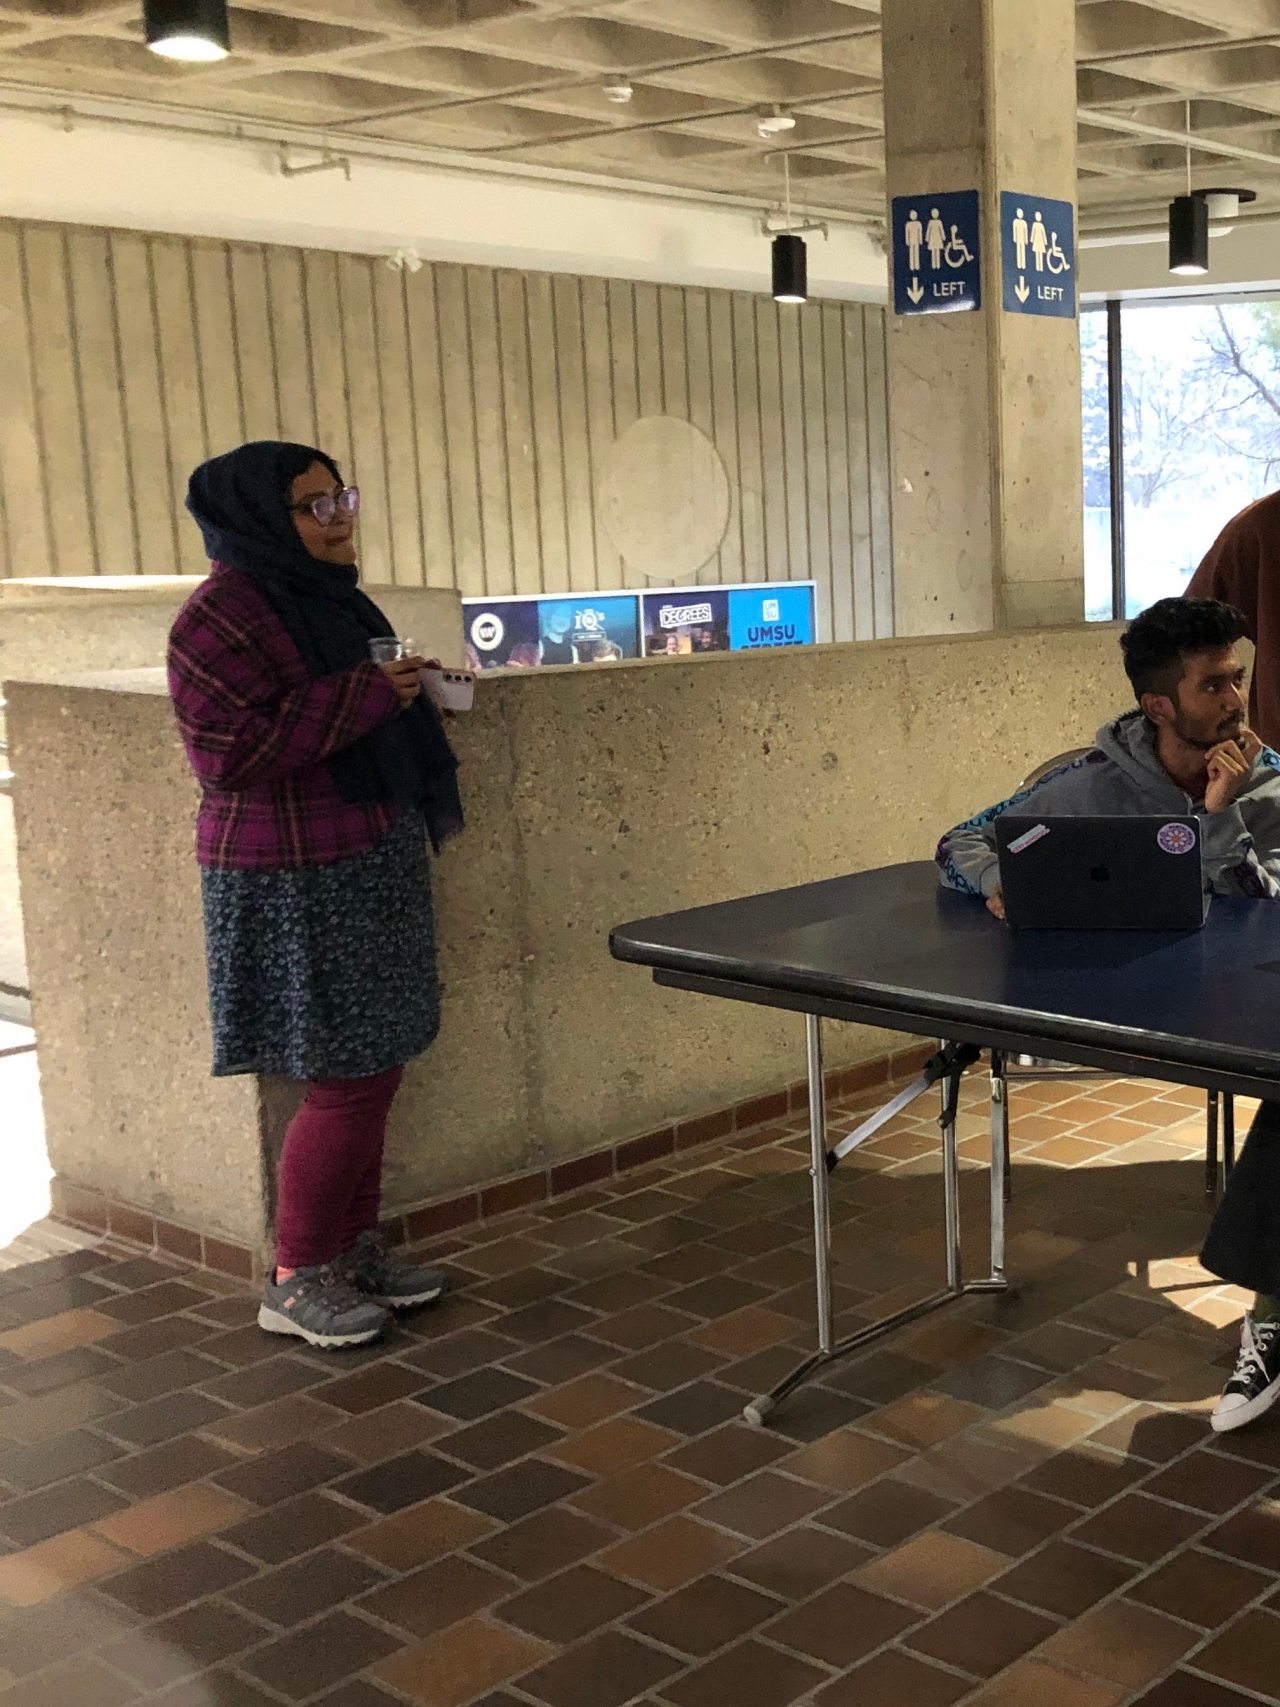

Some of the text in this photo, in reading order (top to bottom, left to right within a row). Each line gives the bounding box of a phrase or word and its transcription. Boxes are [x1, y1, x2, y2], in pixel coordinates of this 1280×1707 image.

[933, 282, 965, 297] LEFT
[1037, 285, 1064, 301] LEFT
[662, 606, 709, 625] DEGREES
[748, 624, 795, 642] UMSU
